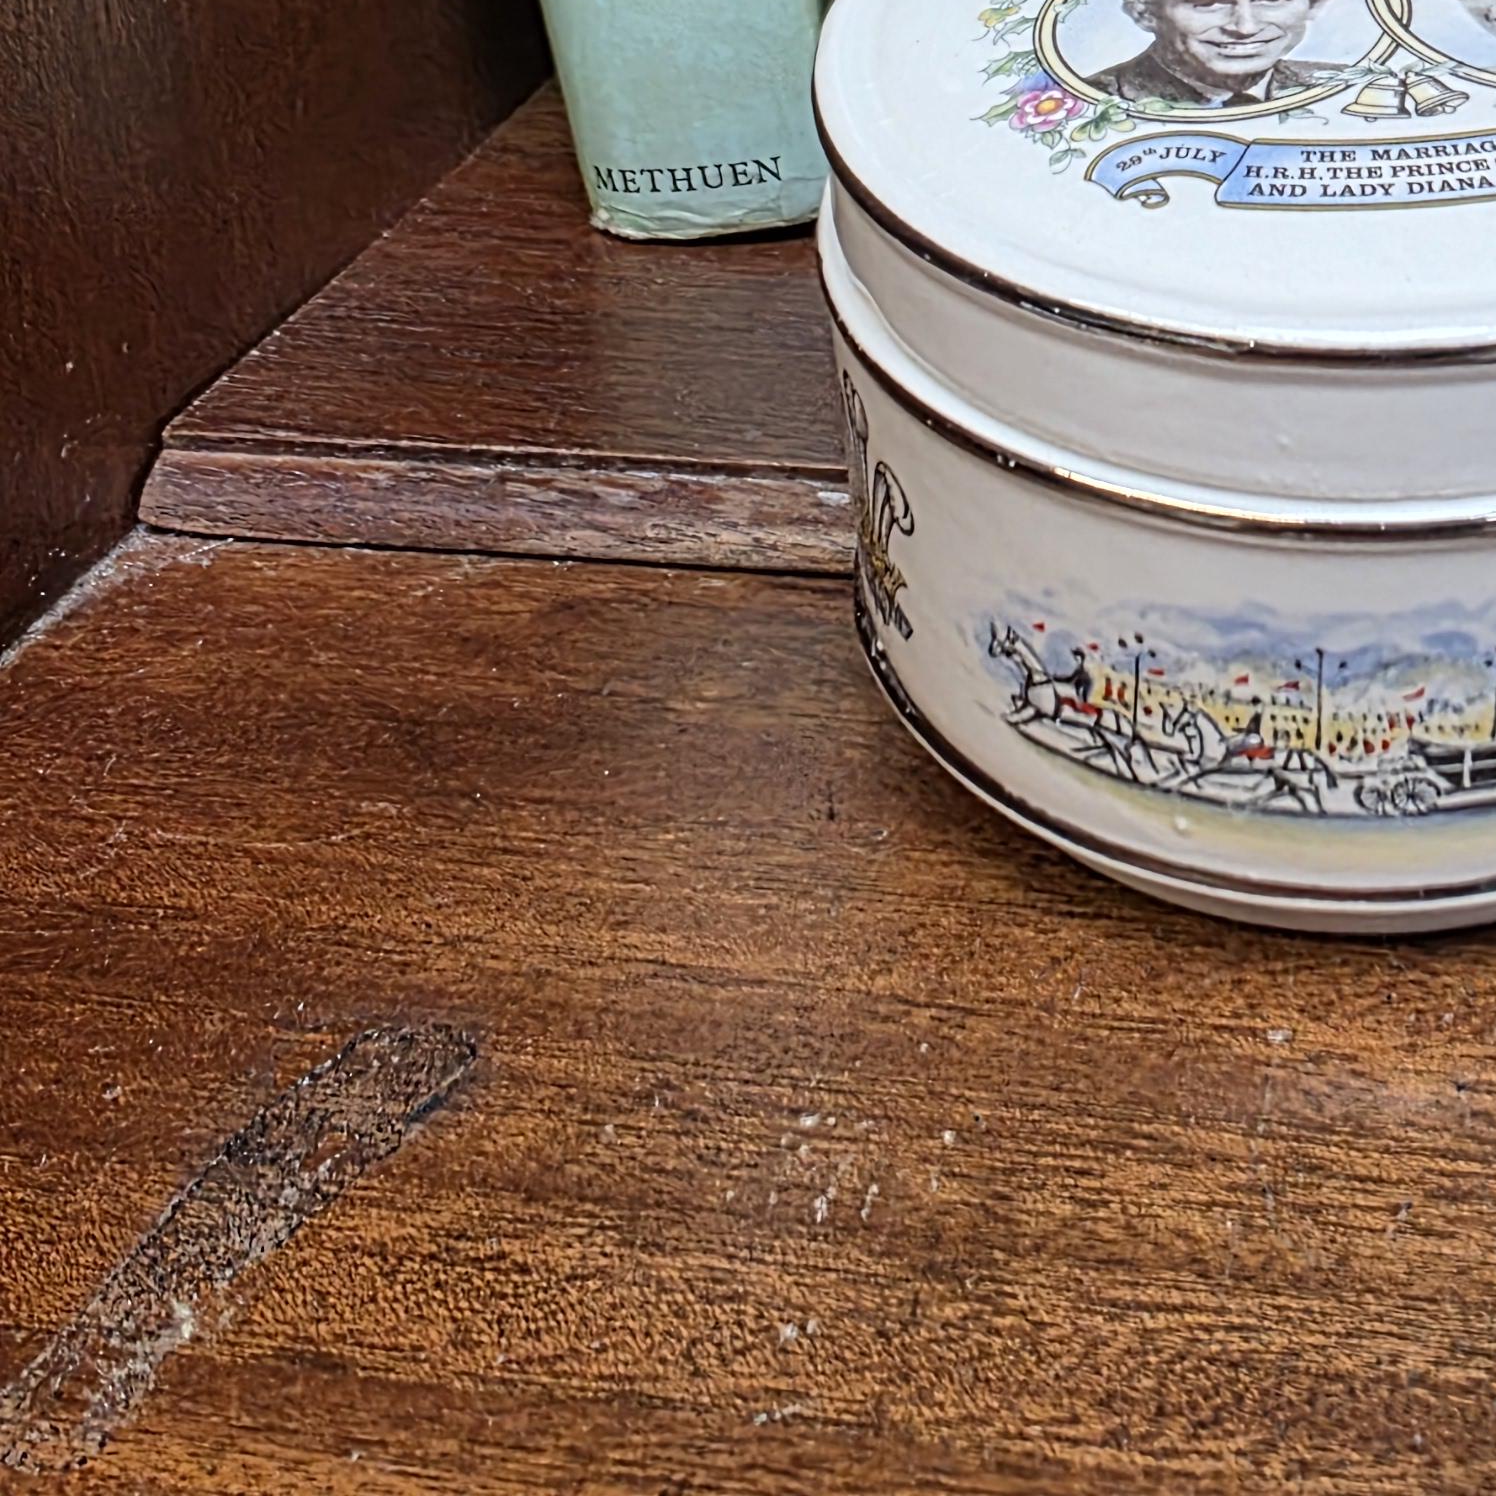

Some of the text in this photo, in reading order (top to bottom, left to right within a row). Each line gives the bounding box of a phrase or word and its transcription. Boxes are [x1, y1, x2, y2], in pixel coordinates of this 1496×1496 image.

[1159, 146, 1228, 164] JULY
[1301, 150, 1357, 163] THE
[593, 155, 783, 194] METHUEN
[1391, 158, 1490, 178] PRINCE
[1248, 183, 1307, 198] AND
[1319, 183, 1395, 197] LADY
[1407, 174, 1494, 195] DIANA
